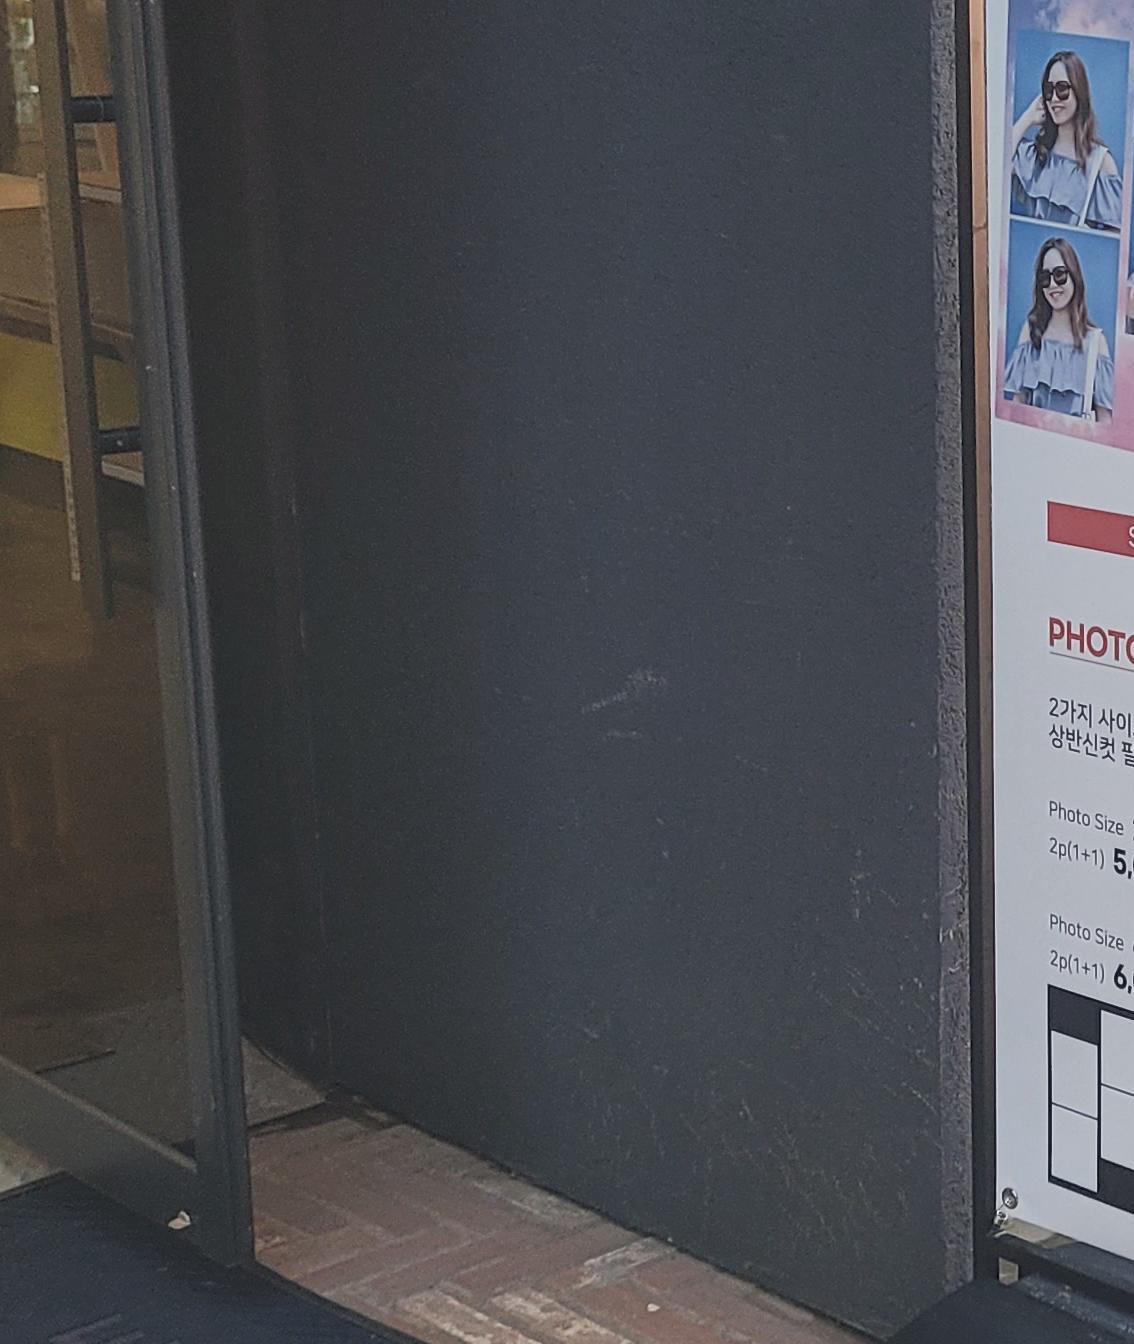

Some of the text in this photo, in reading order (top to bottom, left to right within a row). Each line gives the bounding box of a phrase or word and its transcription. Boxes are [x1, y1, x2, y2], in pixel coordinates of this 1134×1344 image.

[1048, 697, 1093, 729] 2가지
[1048, 723, 1116, 763] 상반신컷
[1048, 800, 1091, 827] Photo
[1094, 813, 1125, 836] Size
[1049, 837, 1105, 870] 2p(1+1)
[1049, 913, 1091, 941] Photo
[1095, 927, 1125, 951] Size
[1050, 949, 1105, 985] 2p(1+1)
